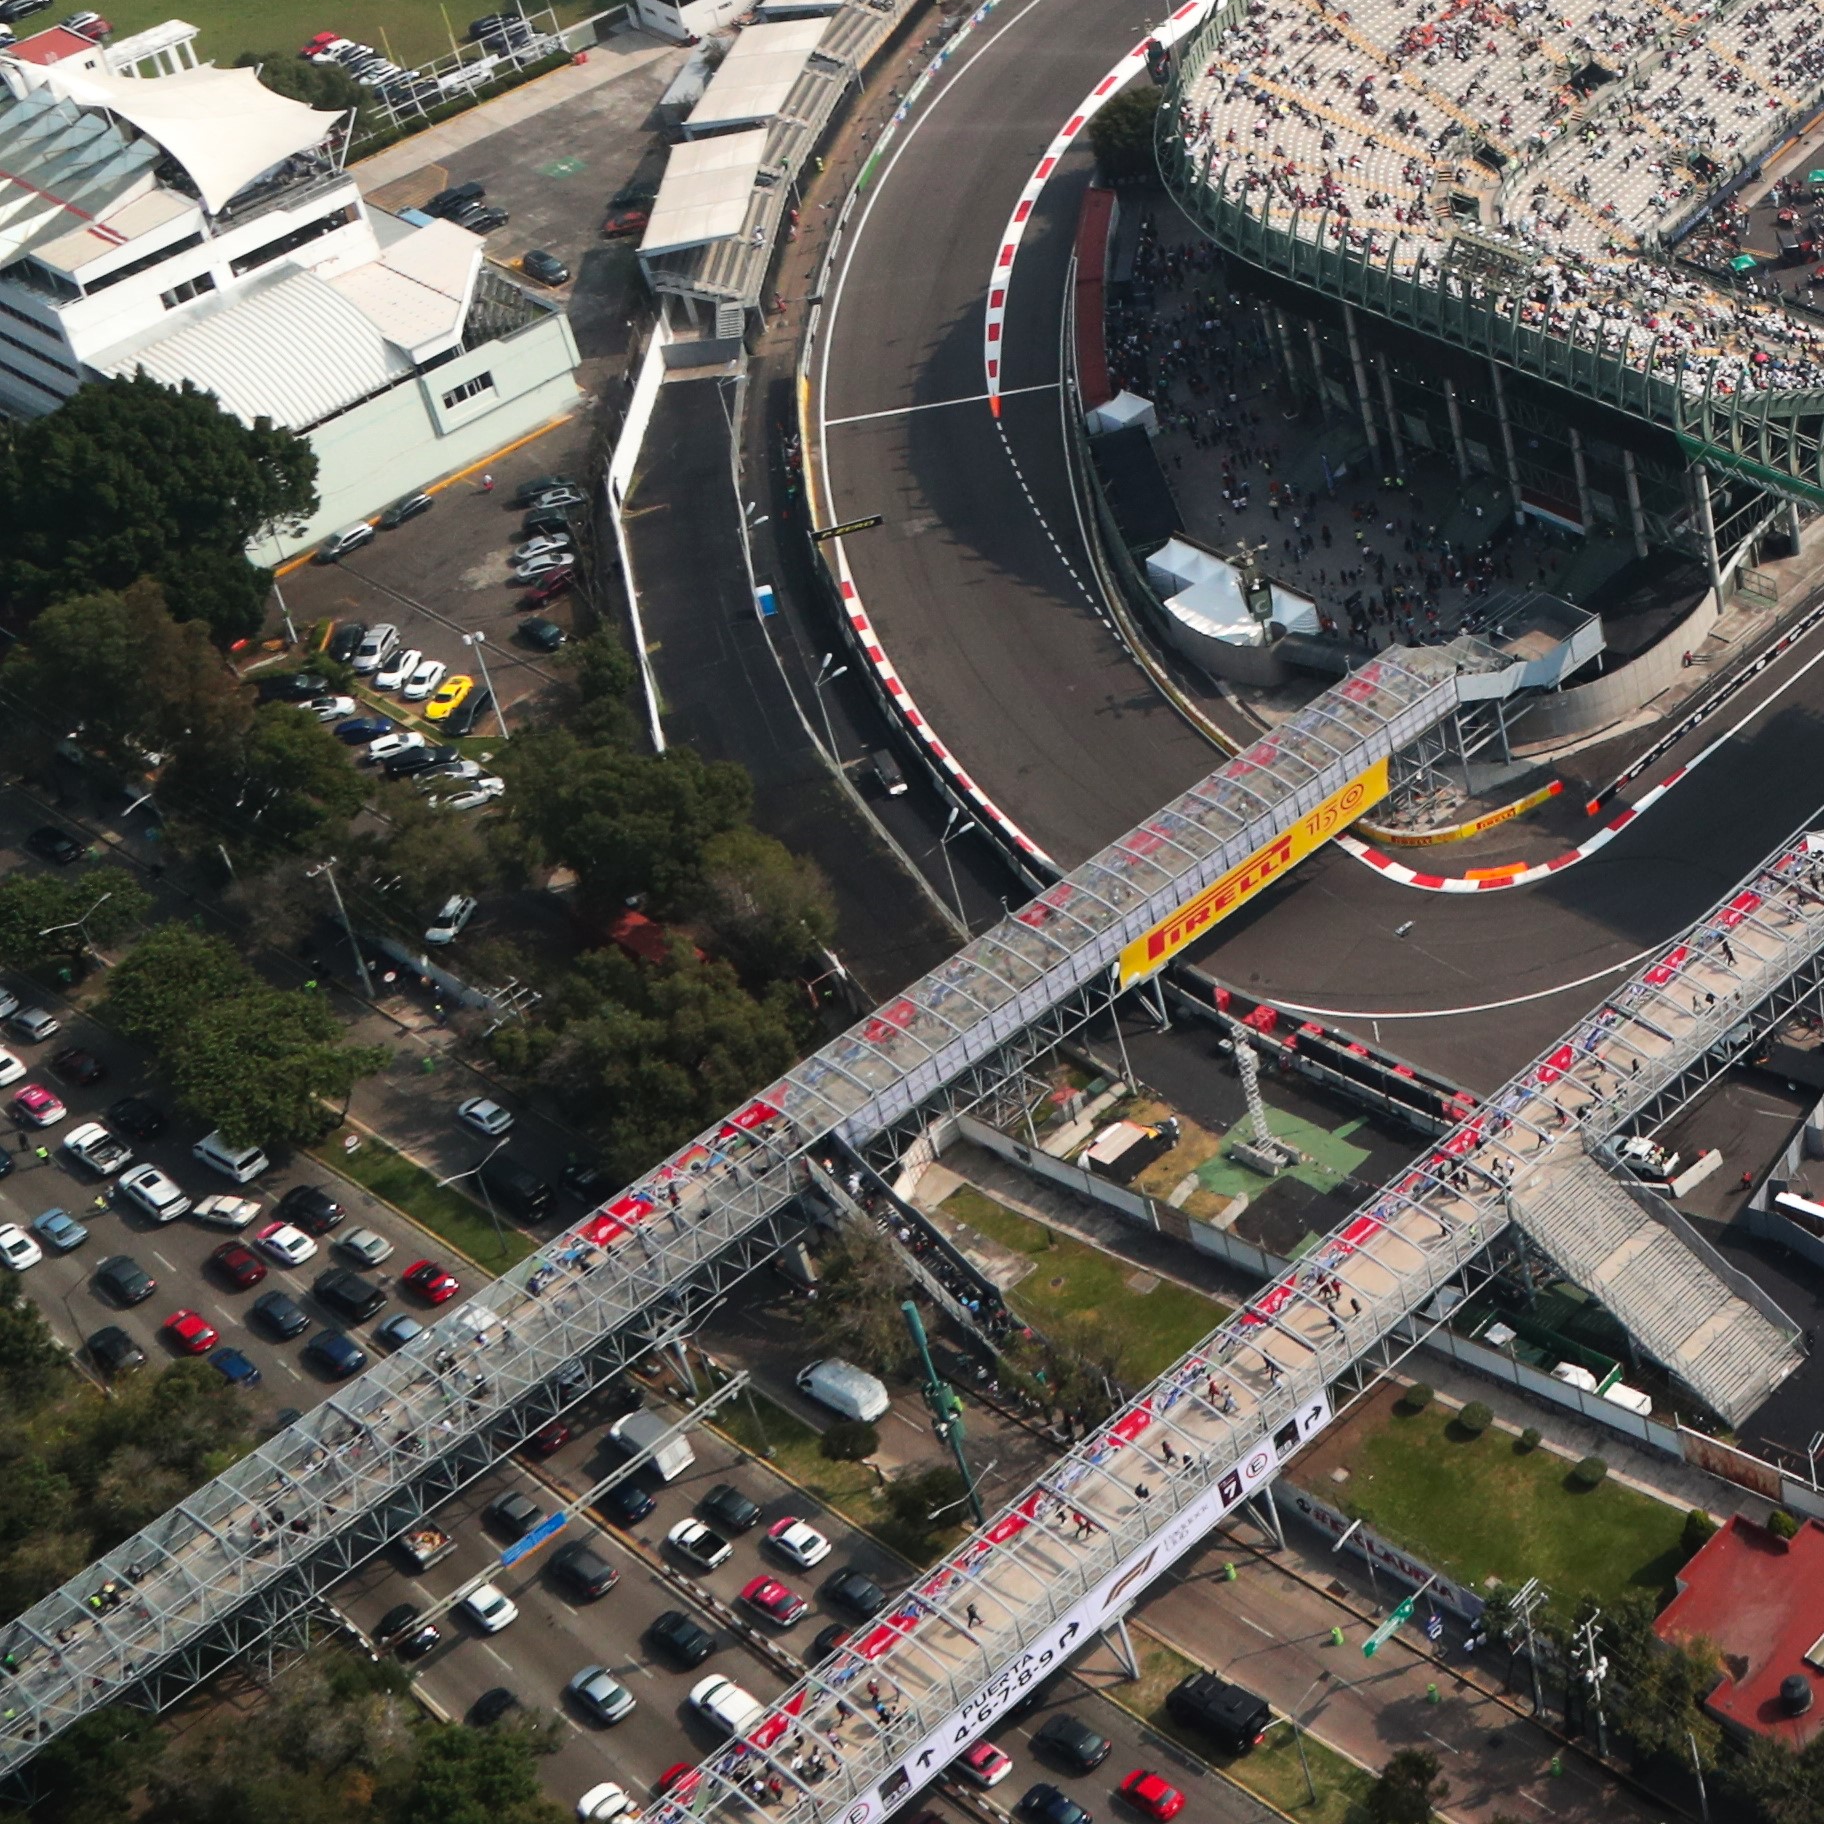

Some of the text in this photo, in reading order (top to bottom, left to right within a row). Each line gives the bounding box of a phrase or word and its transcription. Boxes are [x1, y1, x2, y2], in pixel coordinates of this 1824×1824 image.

[1254, 599, 1268, 613] C
[1148, 834, 1292, 961] PIRELLI
[1224, 1481, 1236, 1502] 7
[953, 1650, 1054, 1744] 4-6-7-8-9
[962, 1652, 1035, 1720] PUERTA
